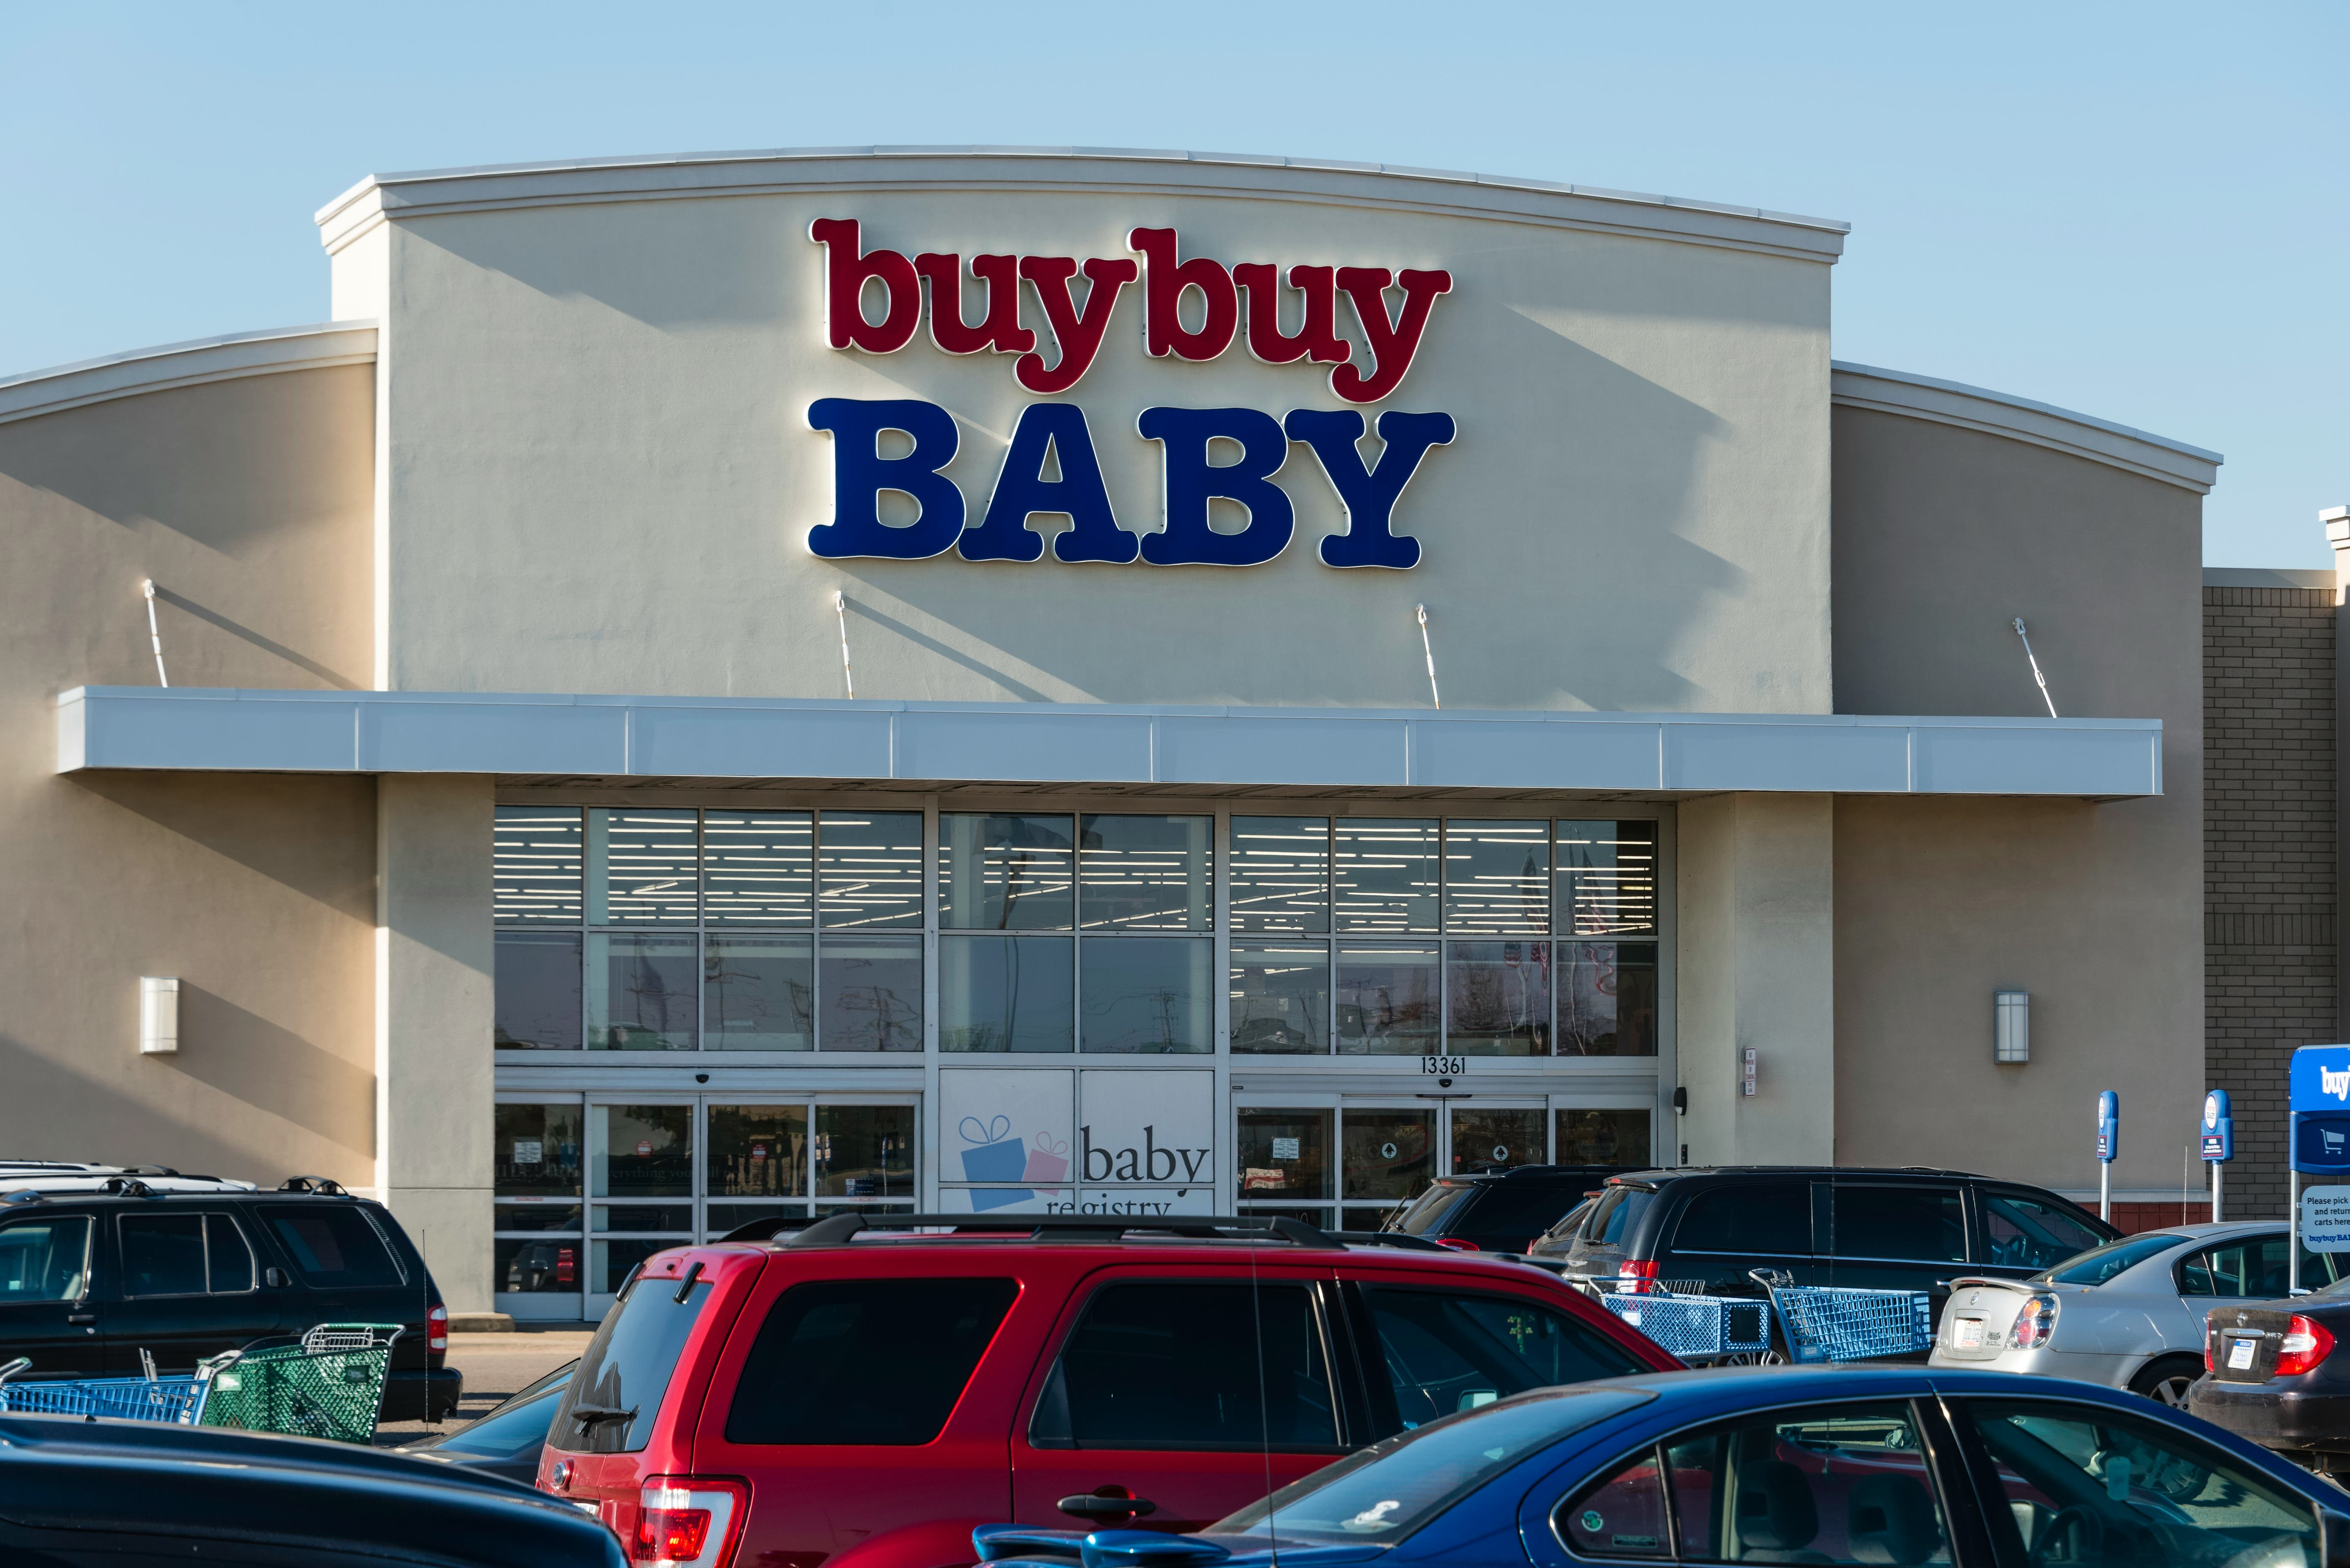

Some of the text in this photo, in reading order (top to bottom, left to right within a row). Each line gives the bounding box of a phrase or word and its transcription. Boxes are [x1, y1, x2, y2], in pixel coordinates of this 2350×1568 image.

[803, 396, 1457, 570] BABY
[1422, 1056, 1465, 1074] 13361
[2320, 1066, 2350, 1101] buy
[1080, 1125, 1210, 1197] baby
[2334, 1196, 2348, 1206] pick
